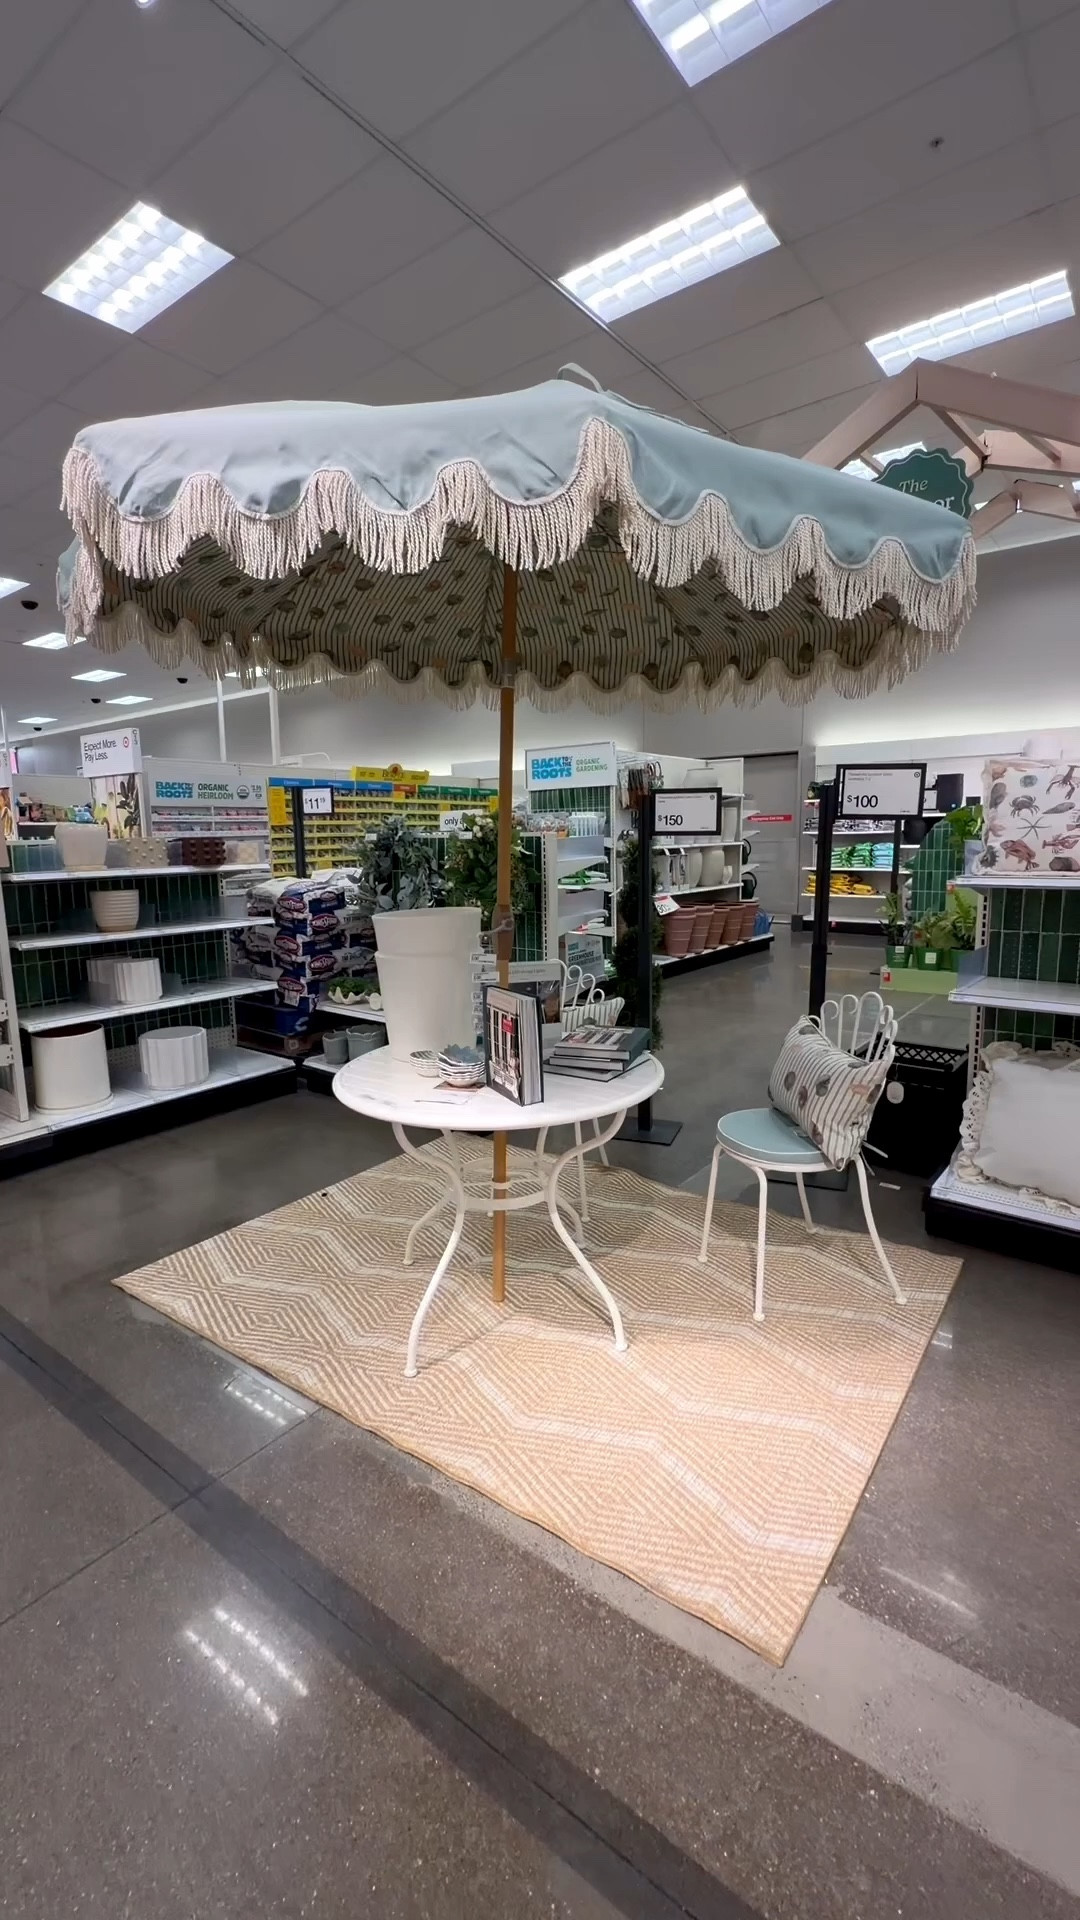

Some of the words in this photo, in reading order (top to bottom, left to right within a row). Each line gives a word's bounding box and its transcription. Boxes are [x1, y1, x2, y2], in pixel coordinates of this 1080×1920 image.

[899, 479, 928, 493] The
[84, 741, 101, 753] Expect
[84, 753, 94, 763] Pay
[576, 758, 600, 766] ORGANIC
[531, 757, 562, 769] BACK
[576, 764, 608, 773] GARDENING
[532, 767, 572, 780] ROOTS
[155, 781, 187, 790] BACK
[198, 783, 229, 791] ORGANIC
[156, 790, 193, 799] ROOTS
[198, 792, 234, 800] HEIRLOOM
[847, 794, 878, 808] $100
[445, 817, 458, 826] only
[657, 814, 683, 826] $150
